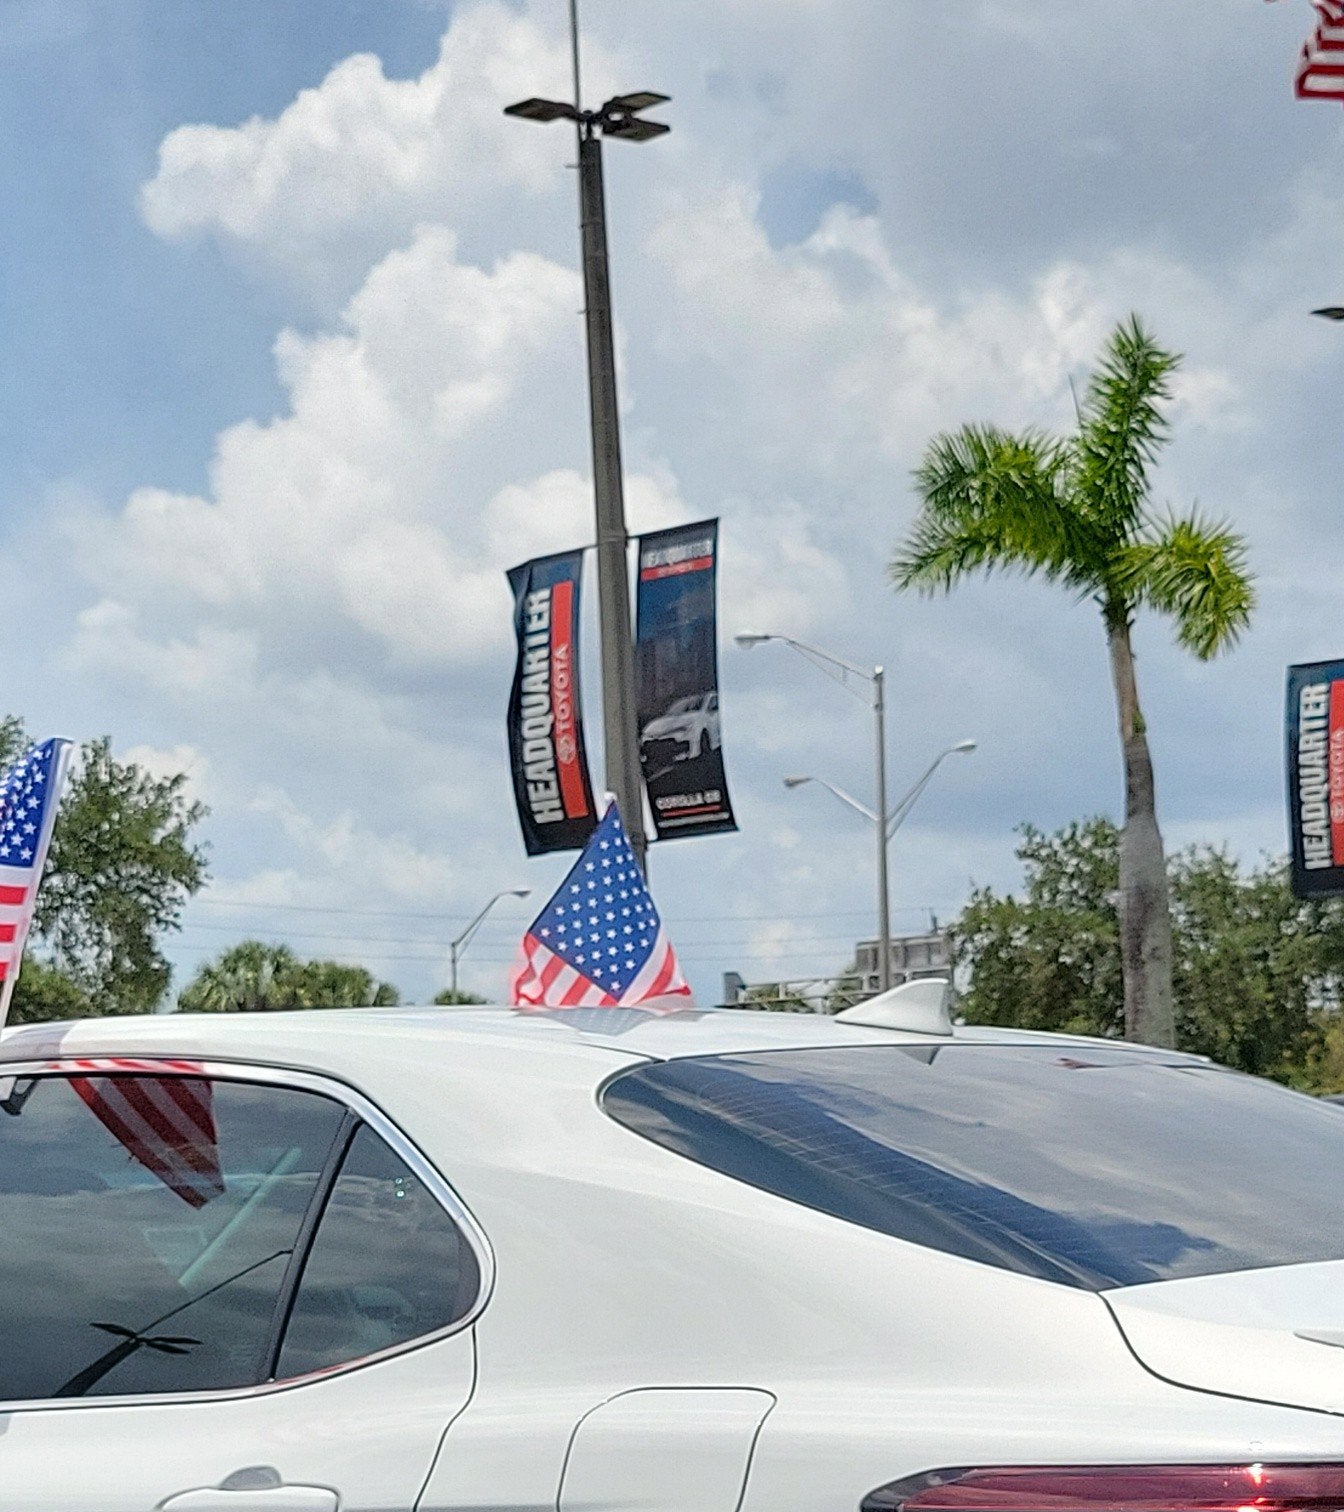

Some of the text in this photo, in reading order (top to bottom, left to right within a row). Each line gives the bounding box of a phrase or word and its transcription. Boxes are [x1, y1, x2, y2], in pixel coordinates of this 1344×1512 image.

[520, 586, 566, 825] HEADQUARTER
[554, 643, 573, 735] TOYOTA
[1298, 682, 1333, 870] HEADQUARTER
